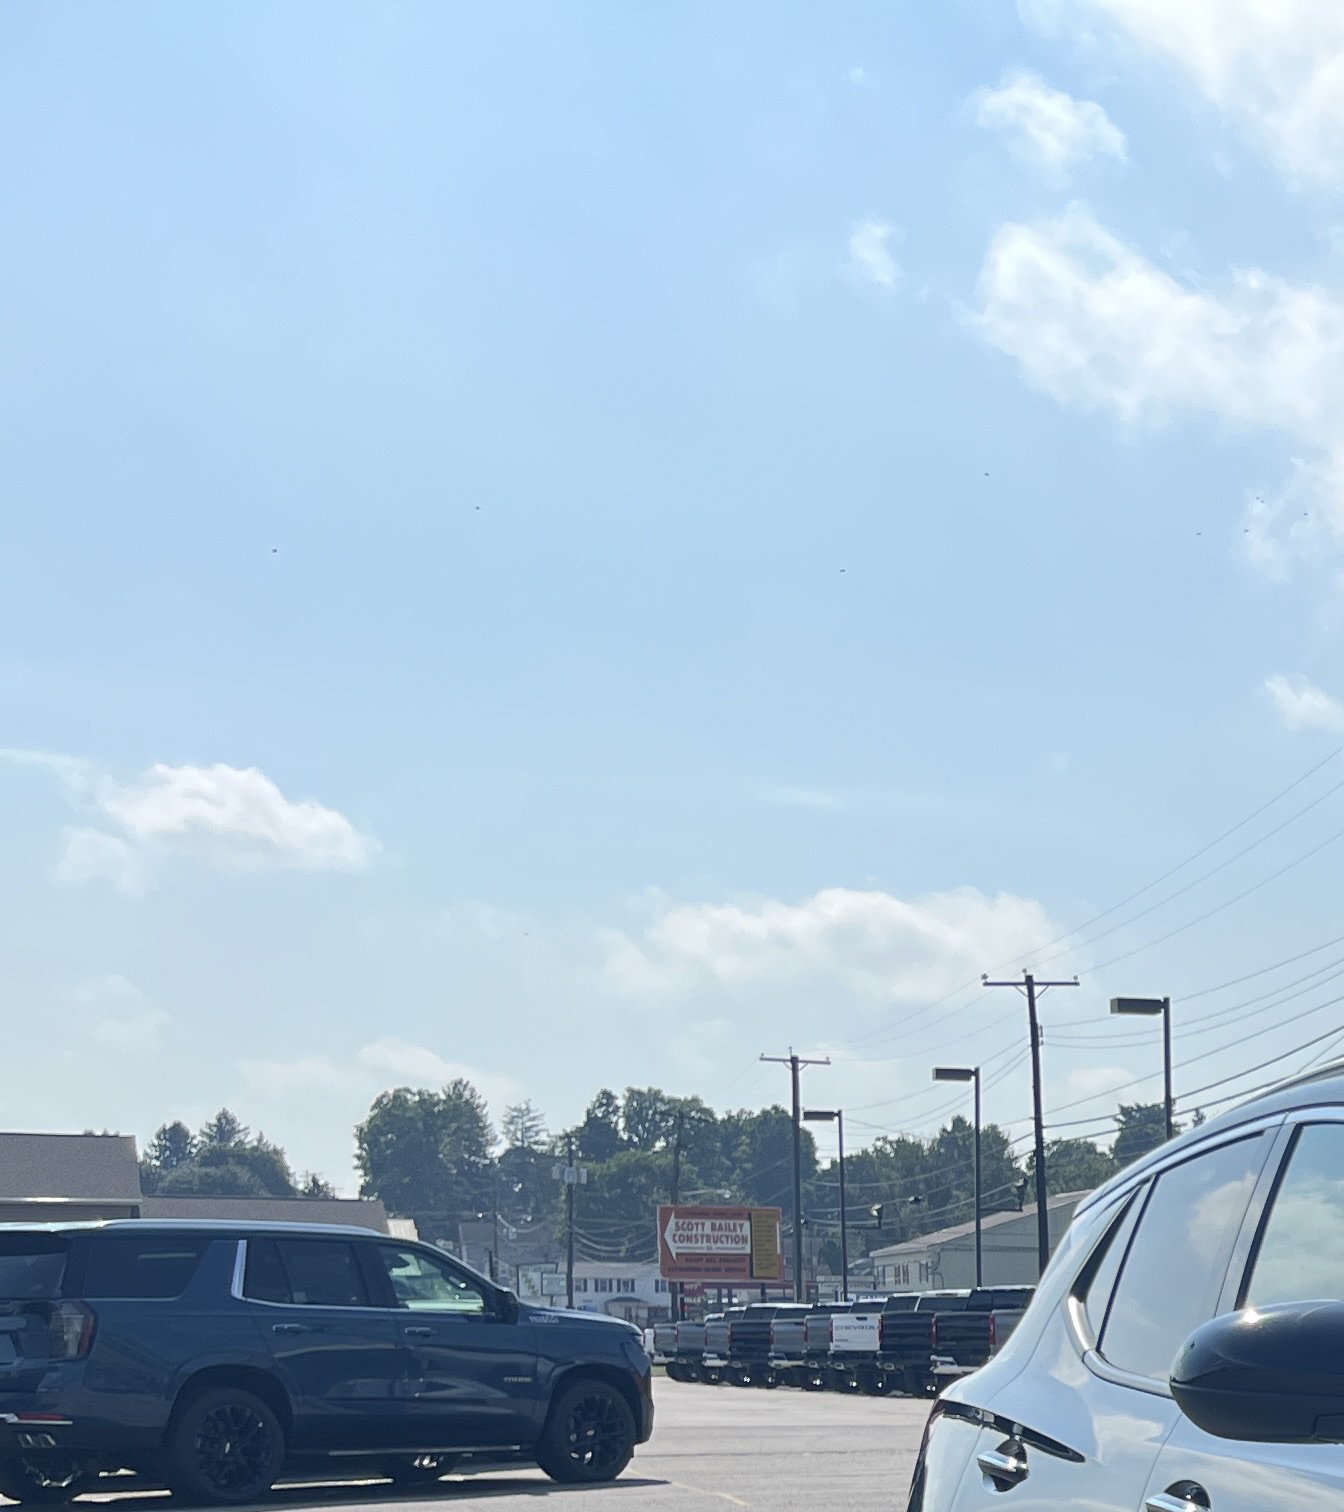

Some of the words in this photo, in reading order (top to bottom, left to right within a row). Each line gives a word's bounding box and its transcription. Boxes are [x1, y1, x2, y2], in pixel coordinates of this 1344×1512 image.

[674, 1221, 706, 1233] SCOTT
[710, 1221, 745, 1233] BAILEY
[672, 1233, 748, 1245] CONSTRUCTION
